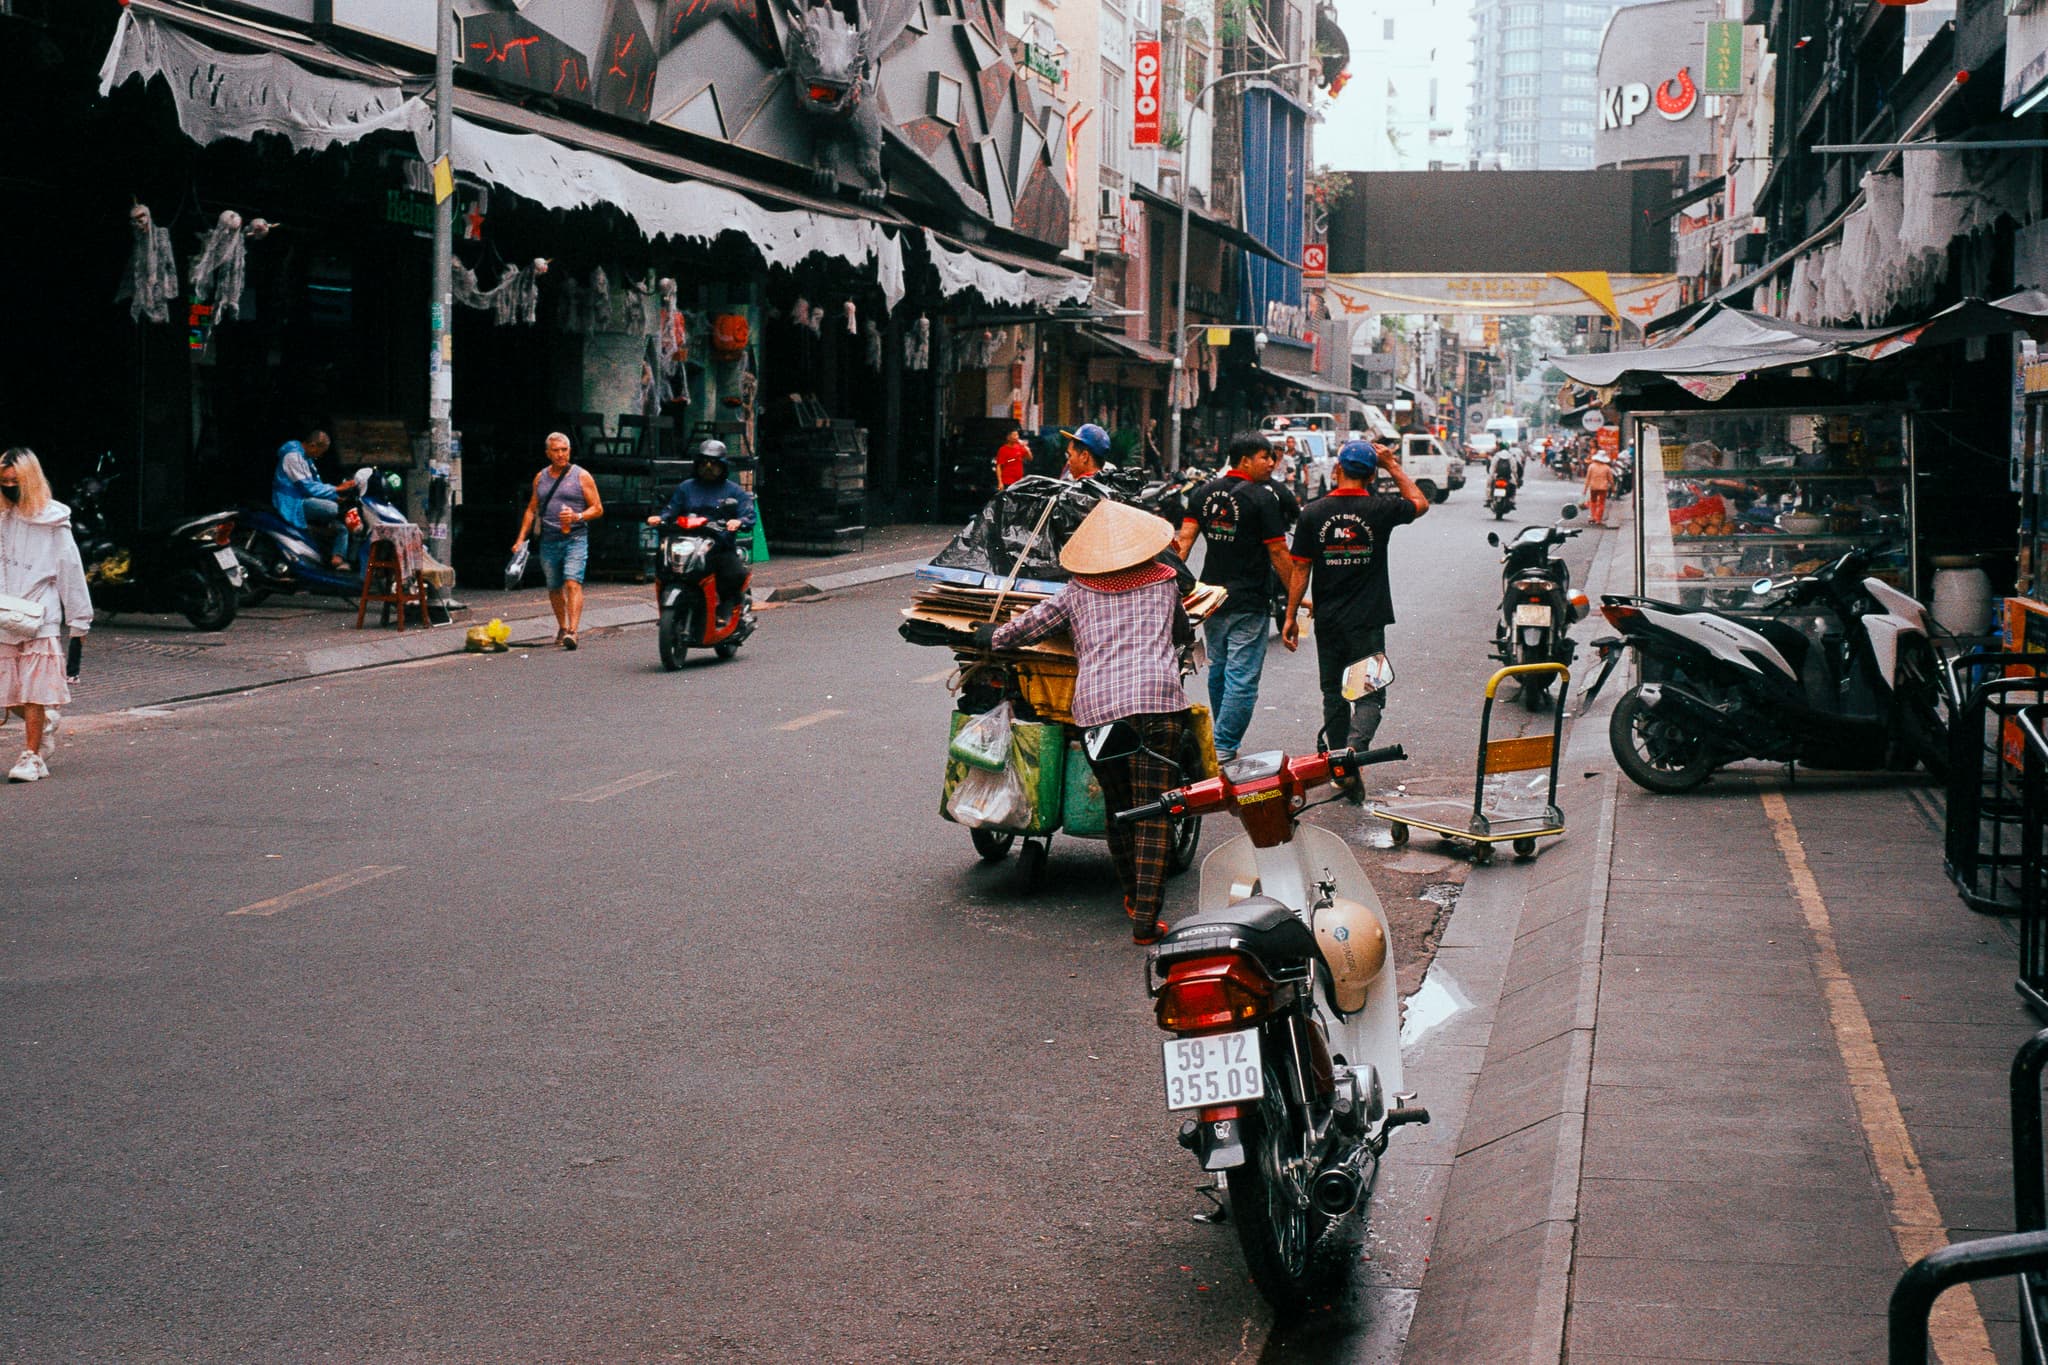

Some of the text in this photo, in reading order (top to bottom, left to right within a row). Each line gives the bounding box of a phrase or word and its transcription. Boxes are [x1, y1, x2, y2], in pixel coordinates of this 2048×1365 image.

[1137, 55, 1158, 116] OYO
[1177, 926, 1232, 940] HONDA
[1177, 1033, 1248, 1072] 59-T2
[1171, 1066, 1260, 1106] 355.09
